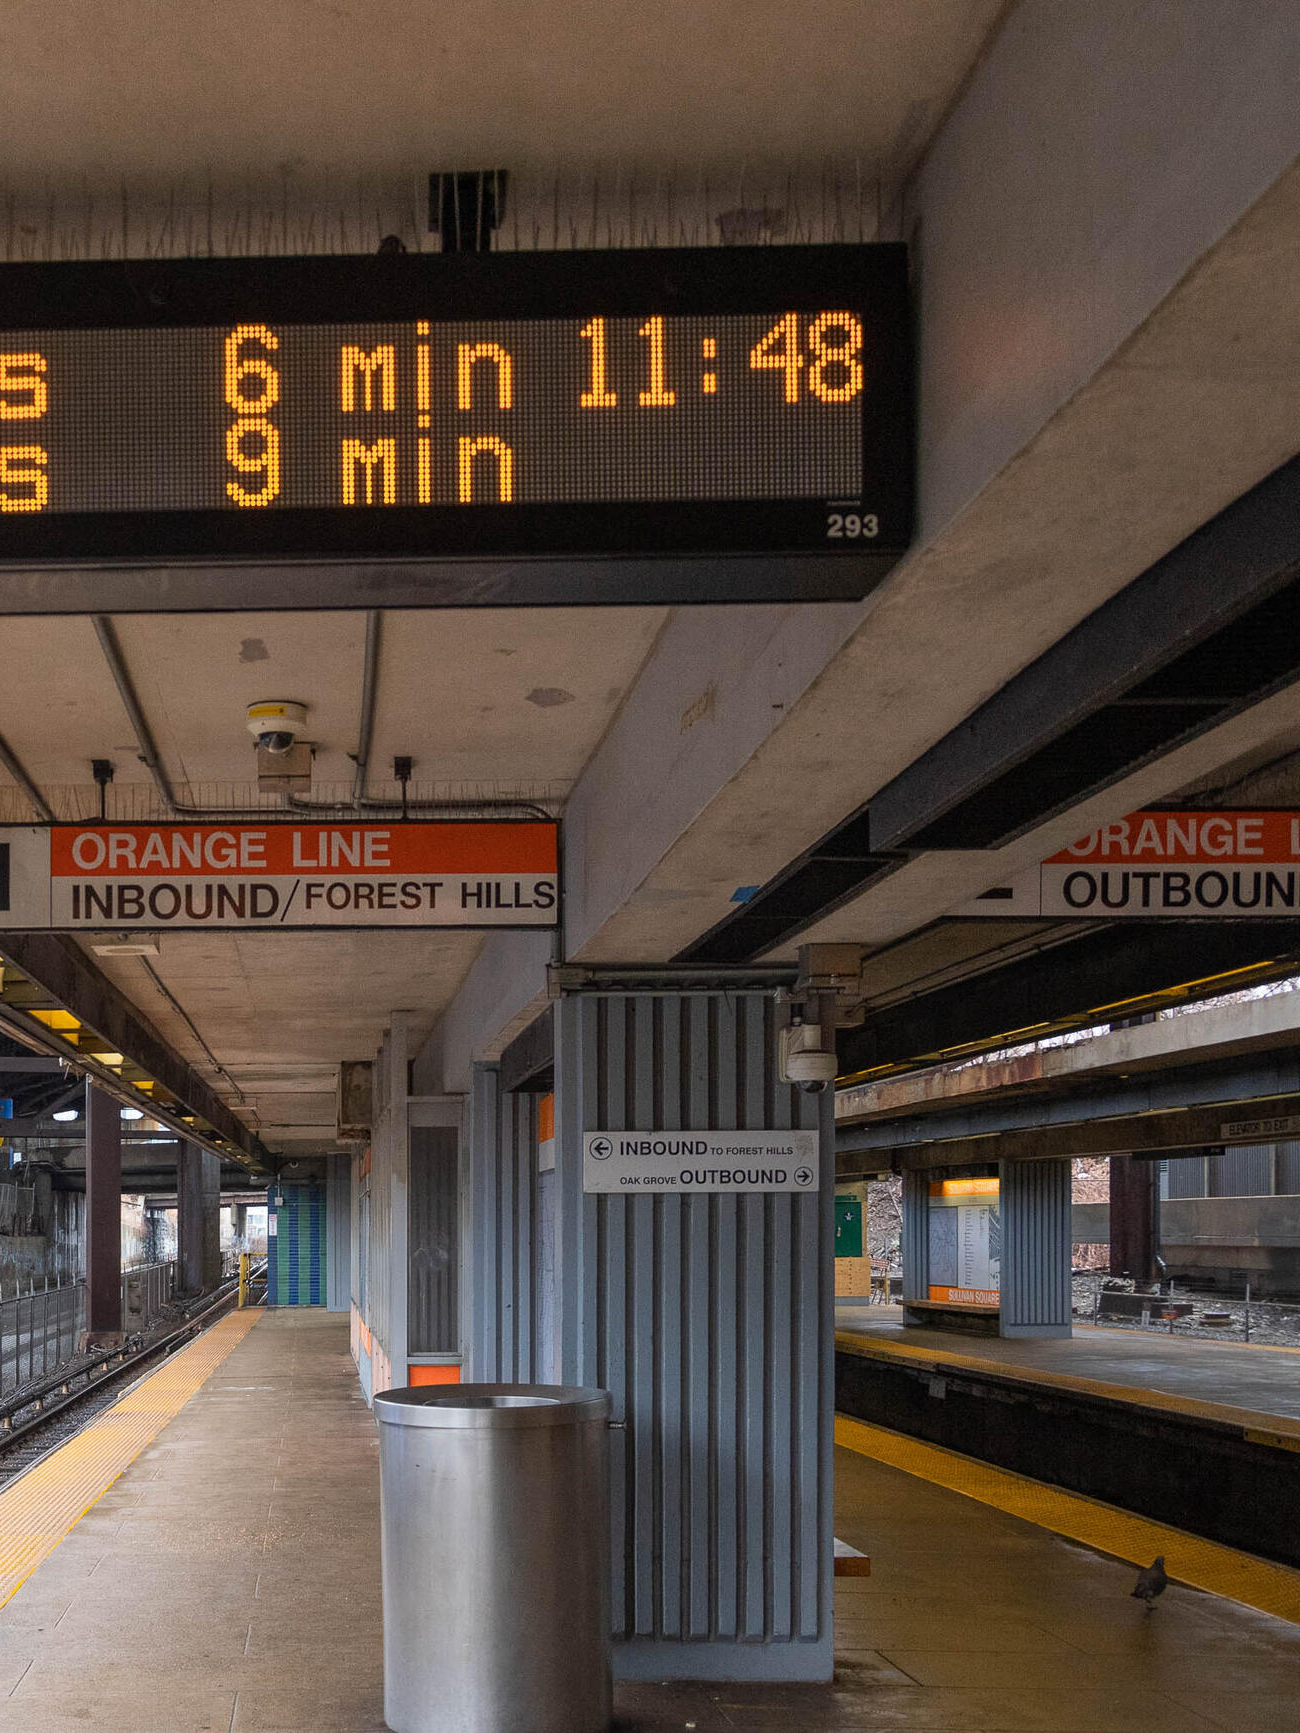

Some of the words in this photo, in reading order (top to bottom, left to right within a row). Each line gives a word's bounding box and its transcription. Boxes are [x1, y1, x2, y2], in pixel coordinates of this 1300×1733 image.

[224, 323, 280, 414] 6
[340, 320, 513, 413] min
[580, 310, 863, 408] 11:48
[225, 417, 280, 507] 9
[340, 415, 514, 504] min
[827, 513, 879, 538] 293
[72, 832, 267, 870] ORANGE
[293, 831, 391, 867] LINE
[461, 880, 555, 909] HILLS
[1063, 871, 1300, 908] OUTBOUN
[620, 1141, 707, 1156] INBOUND
[710, 1147, 723, 1155] TO
[726, 1147, 763, 1155] FOREST
[766, 1147, 793, 1155] HILLS
[620, 1176, 640, 1185] OAK
[643, 1176, 676, 1185] GROVE
[680, 1169, 787, 1185] OUTBOUND
